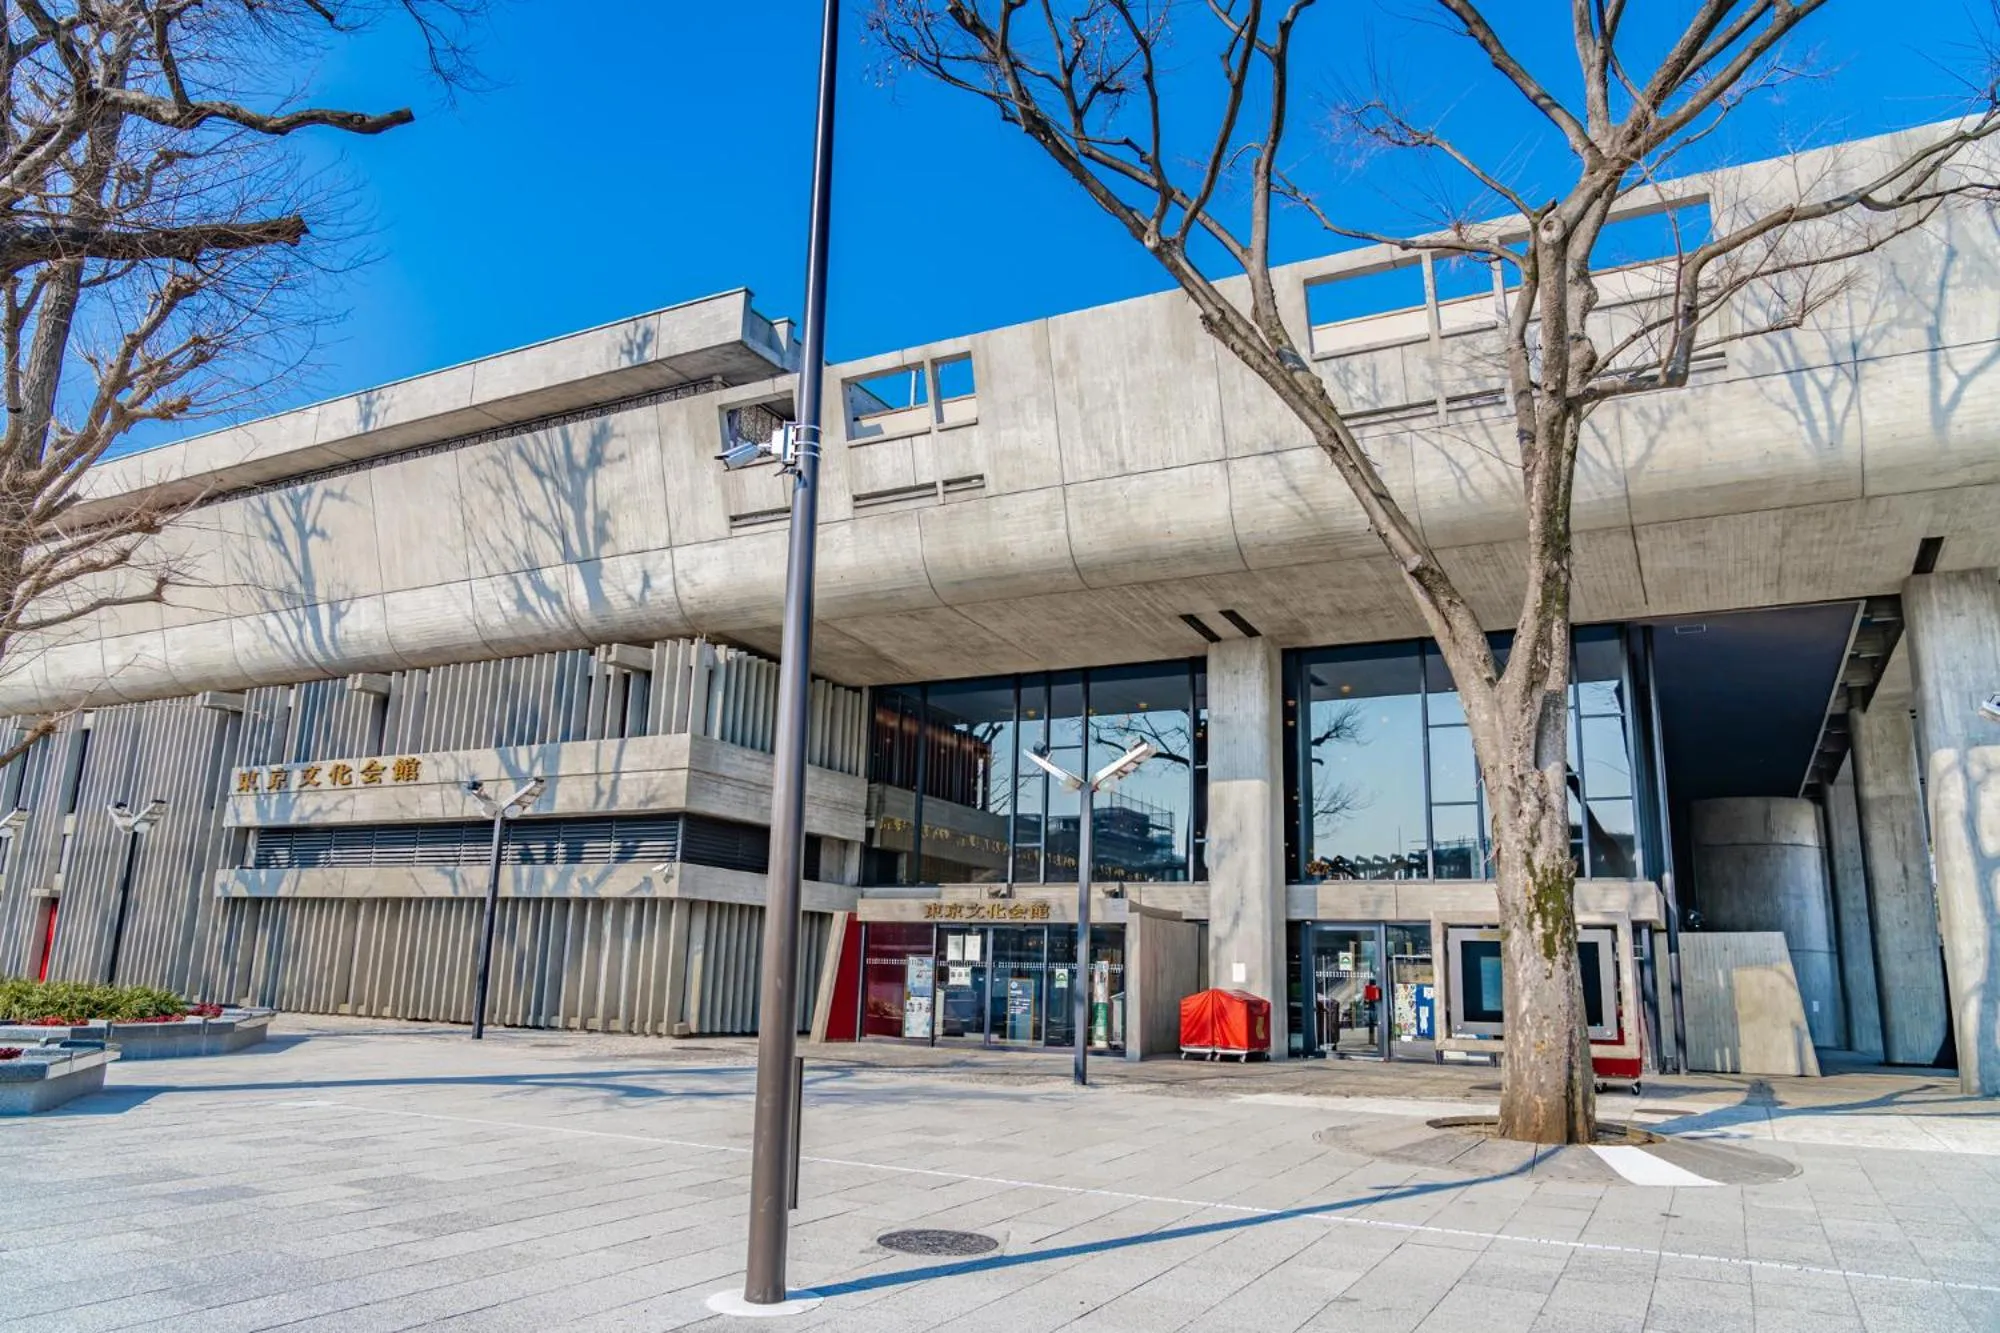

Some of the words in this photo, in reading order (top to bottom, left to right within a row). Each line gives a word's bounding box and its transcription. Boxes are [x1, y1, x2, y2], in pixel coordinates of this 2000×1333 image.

[238, 757, 421, 792] 東京文化会館
[924, 902, 1050, 920] 東京文化会館
